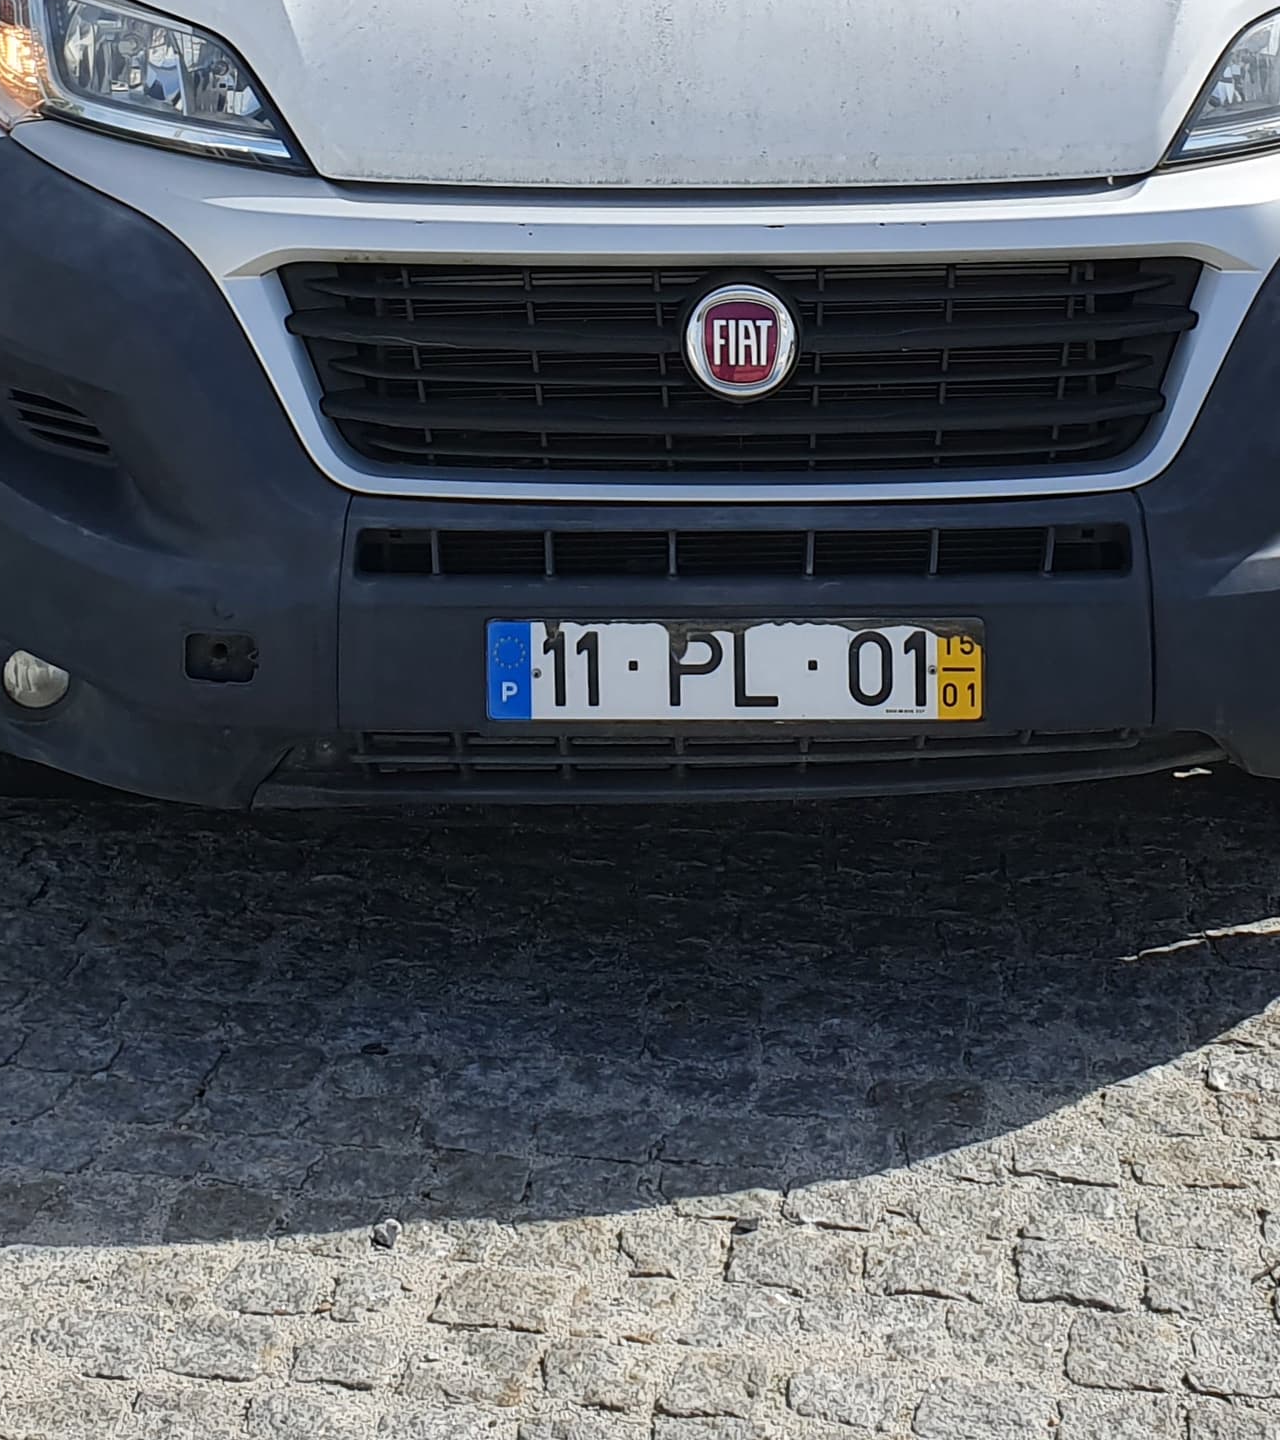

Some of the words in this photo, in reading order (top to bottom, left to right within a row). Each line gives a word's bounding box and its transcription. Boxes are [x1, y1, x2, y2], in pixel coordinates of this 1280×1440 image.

[713, 319, 773, 366] FIAT
[502, 681, 518, 703] P
[942, 683, 976, 707] 01
